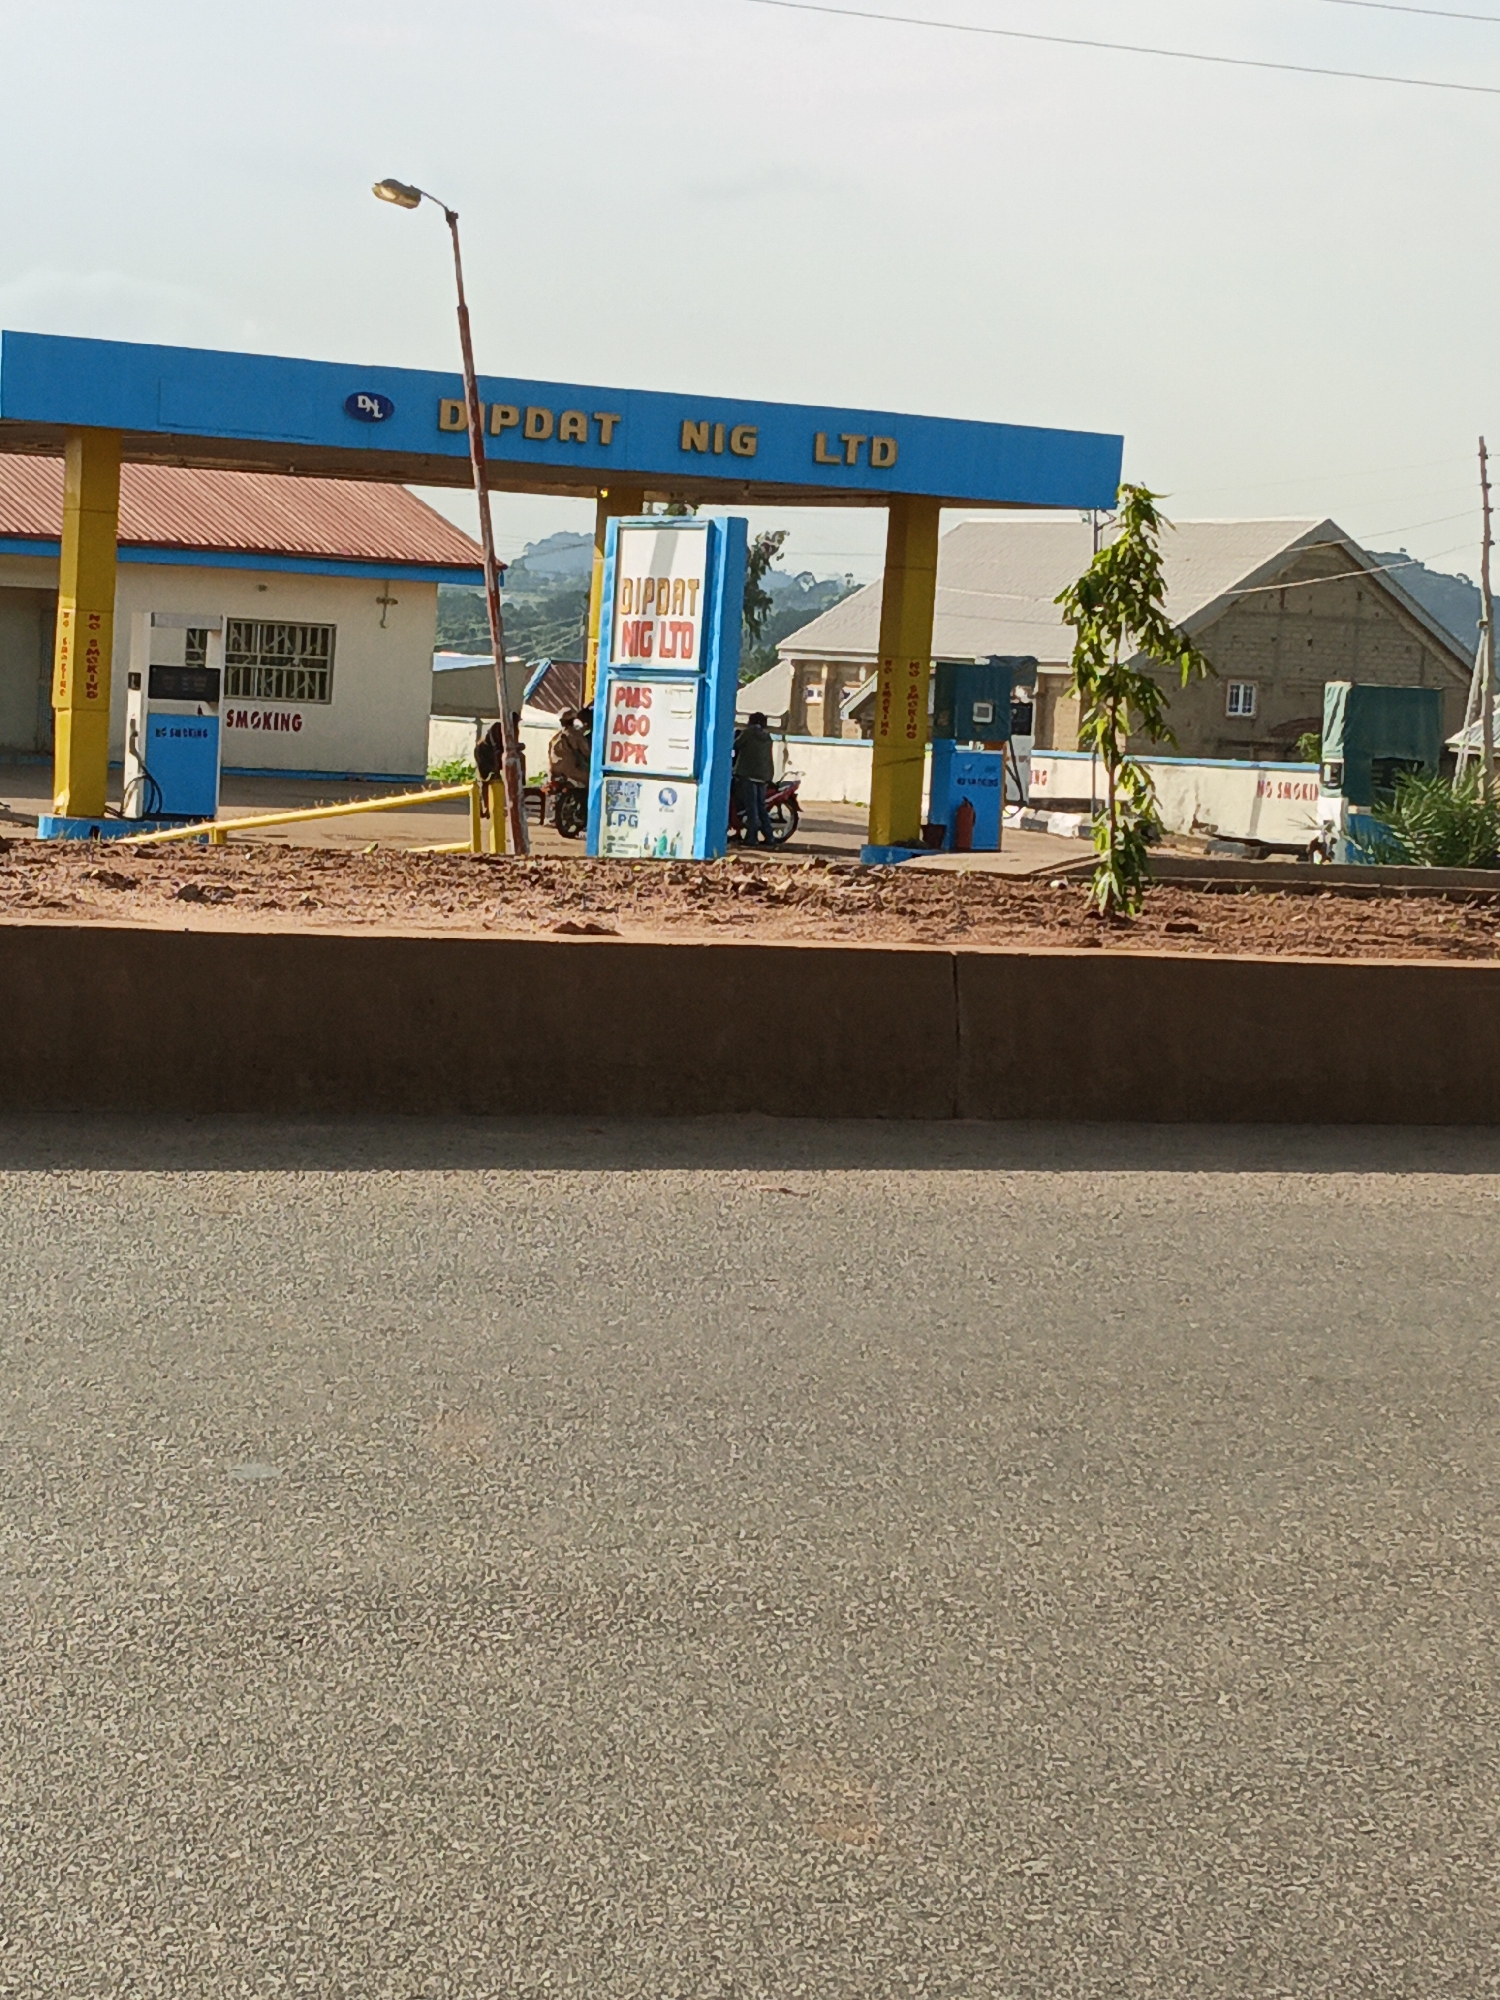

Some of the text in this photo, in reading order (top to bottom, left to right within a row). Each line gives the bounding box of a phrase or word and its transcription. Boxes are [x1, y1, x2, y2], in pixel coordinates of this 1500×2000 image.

[357, 395, 384, 418] DNL
[681, 419, 758, 456] NIG
[813, 431, 898, 468] LTD
[620, 577, 700, 616] DIPDAT
[621, 620, 694, 659] NIG LTD
[615, 686, 652, 710] PMS
[226, 709, 302, 732] SMOKING
[613, 714, 650, 737] AGO
[610, 741, 648, 765] DPK
[1257, 780, 1318, 800] NO SMOKIN
